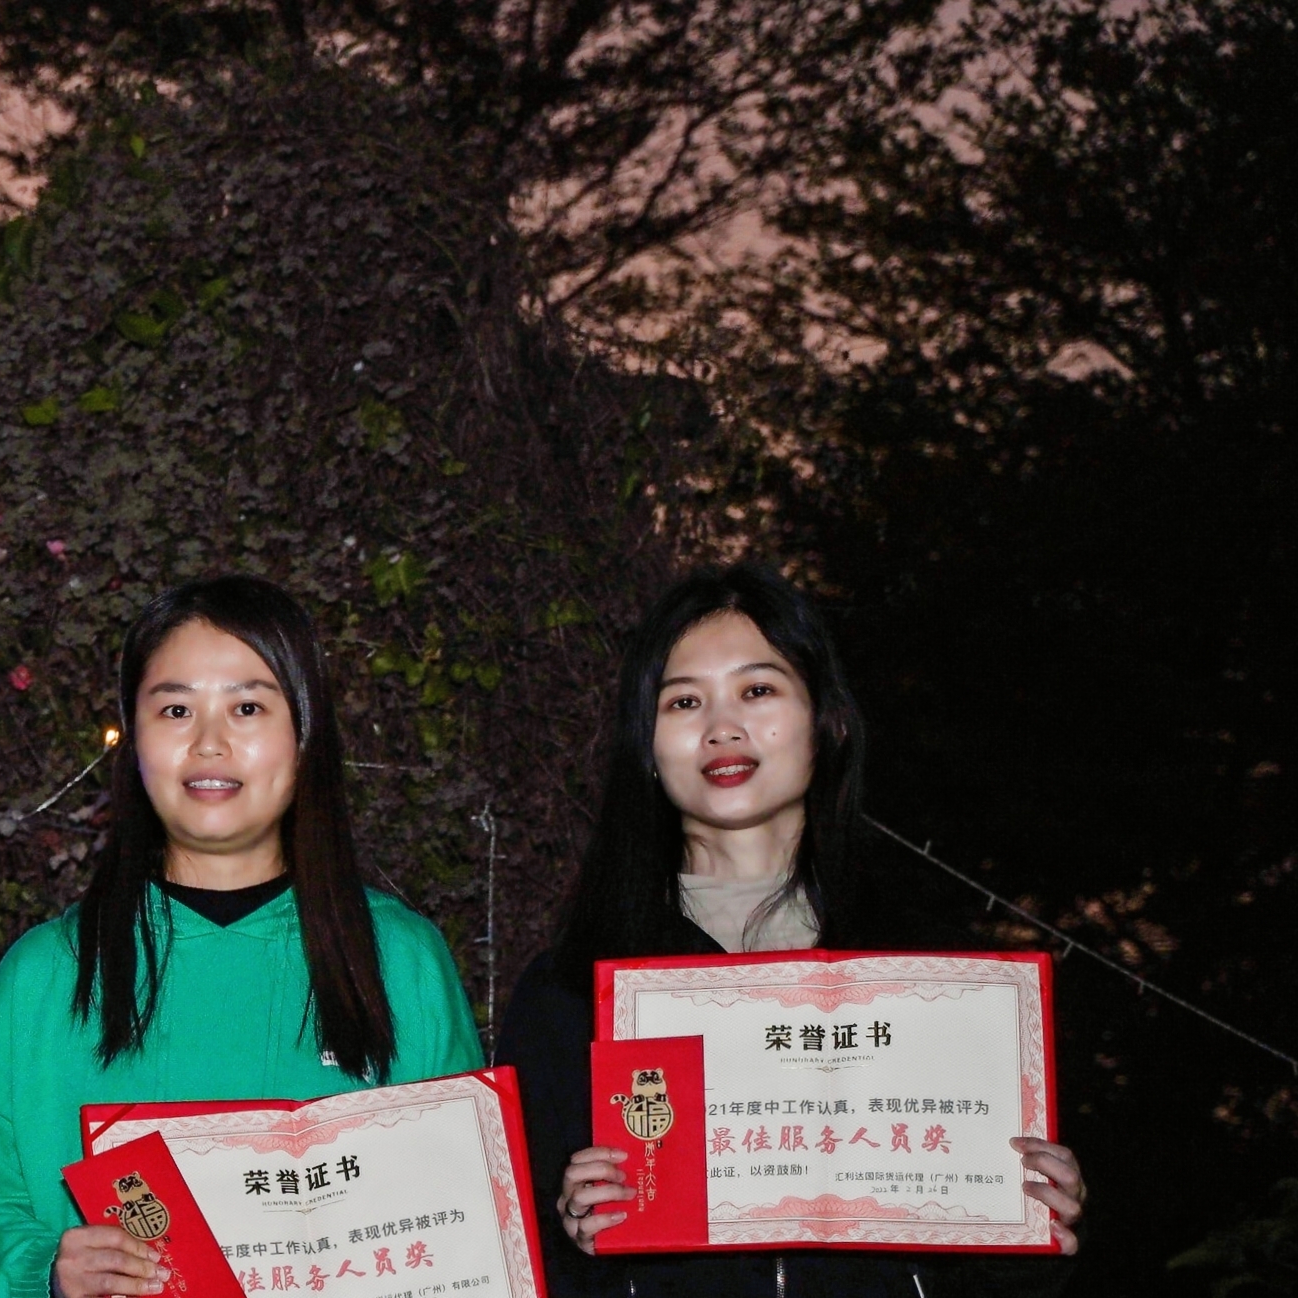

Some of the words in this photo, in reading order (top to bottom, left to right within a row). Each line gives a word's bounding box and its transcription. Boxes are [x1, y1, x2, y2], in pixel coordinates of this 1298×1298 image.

[765, 1020, 891, 1051] 荣誉证书
[705, 1098, 990, 1116] 21年度中工作认真，表现优异被评为
[707, 1123, 952, 1156] 最佳服务人员奖
[243, 1155, 360, 1195] 荣誉证书
[706, 1164, 808, 1179] 此证，以资鼓励！
[238, 1241, 434, 1293] 佳服务人员奖
